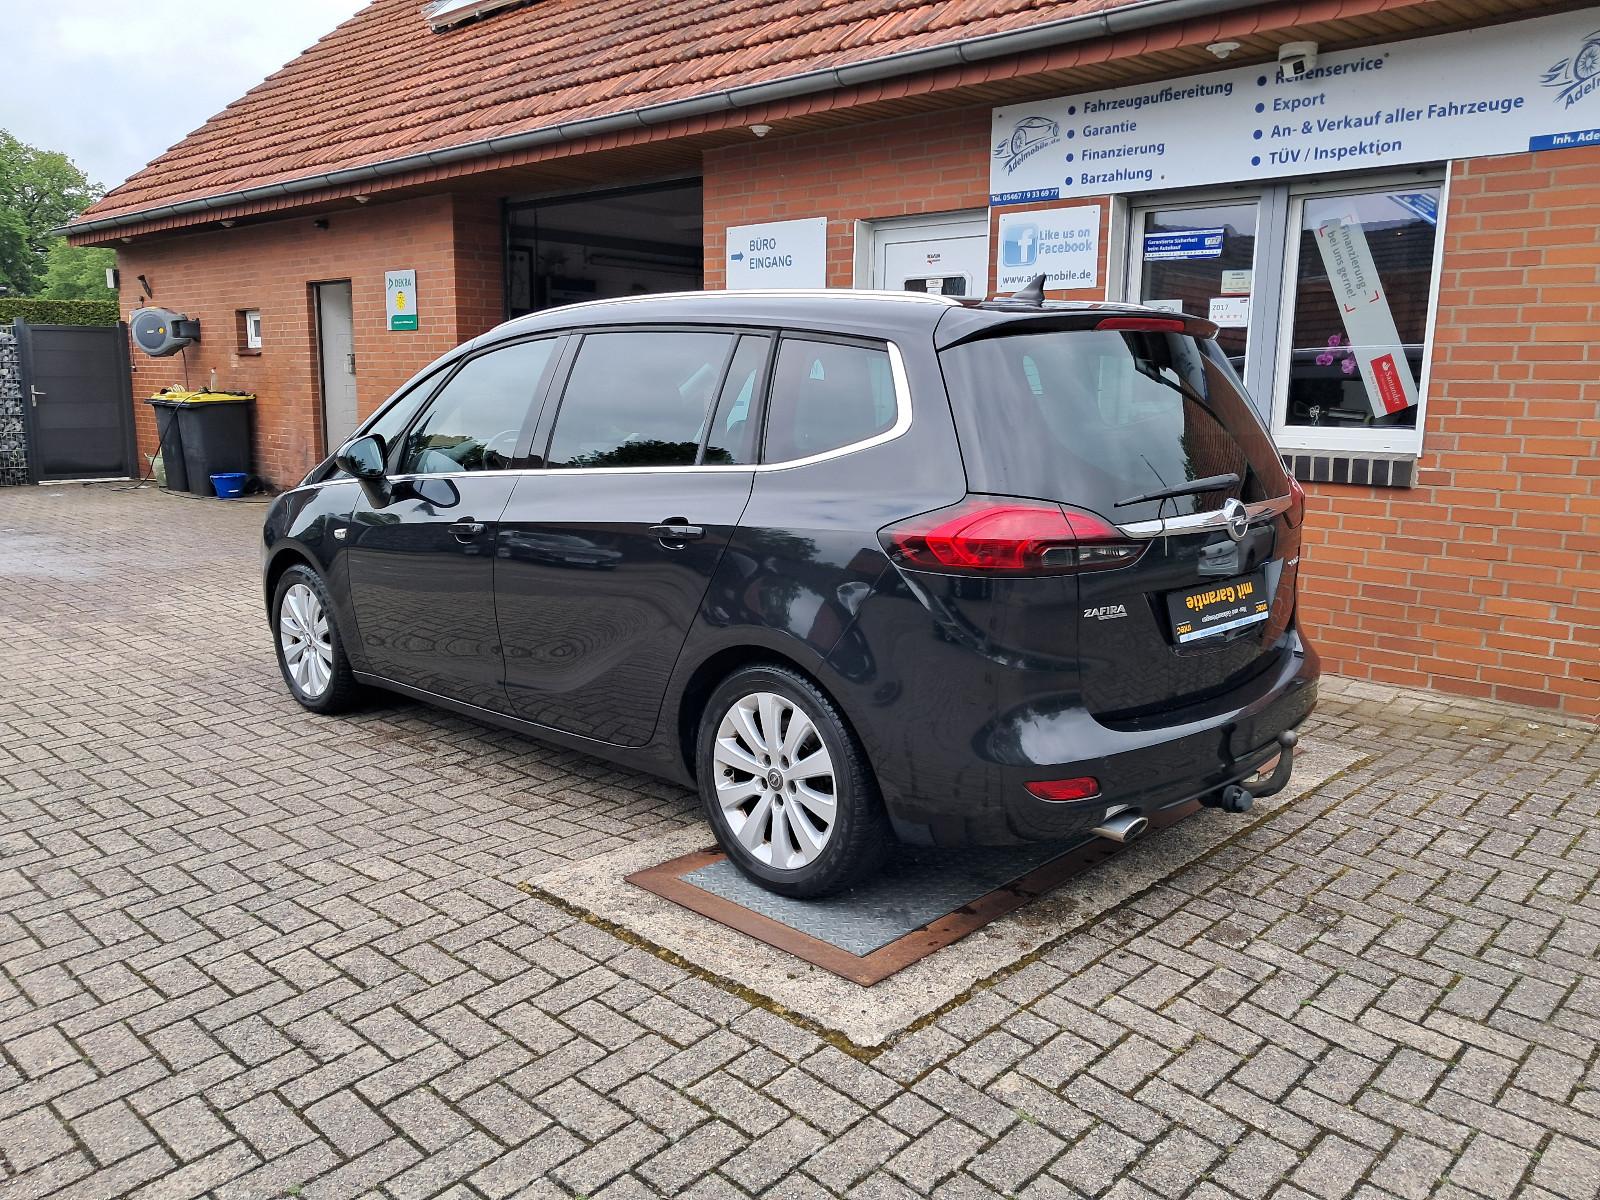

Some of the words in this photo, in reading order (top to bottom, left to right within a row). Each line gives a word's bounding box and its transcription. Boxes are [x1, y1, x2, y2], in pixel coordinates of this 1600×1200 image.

[1275, 58, 1383, 84] Renservice
[1084, 82, 1233, 113] Fahrzeugaufbereitung
[1273, 93, 1325, 112] Export
[1271, 125, 1297, 138] An-
[1302, 121, 1313, 134] &
[1317, 111, 1382, 132] Verkauf
[1385, 108, 1423, 124] aller
[1427, 97, 1524, 118] Fahrzeuge
[1083, 120, 1137, 137] Garantie
[1552, 135, 1574, 145] Inh.
[1081, 143, 1165, 162] Finanzierung
[1269, 147, 1301, 164] TÜV
[1304, 148, 1310, 162] /
[1314, 140, 1402, 161] Inspektion
[1081, 168, 1153, 185] Barzahlung
[1032, 190, 1039, 198] 33
[1041, 189, 1049, 197] 69
[1051, 188, 1059, 196] 77
[750, 237, 776, 251] BÜRO
[1039, 230, 1060, 241] Like
[1063, 228, 1074, 239] us
[1078, 228, 1090, 238] on
[1327, 229, 1337, 248] bei
[1038, 240, 1093, 255] Facebook
[1340, 224, 1367, 290] Finanzierung
[750, 255, 792, 269] EINGANG
[1333, 248, 1344, 267] uns
[394, 278, 412, 288] DEKRA
[1003, 269, 1091, 285] www.admobile.de
[1337, 266, 1357, 299] gerne!
[1385, 370, 1400, 405] Santander
[1185, 586, 1236, 612] Garantie
[1236, 581, 1254, 600] mit
[1083, 604, 1126, 618] ZAFIRA
